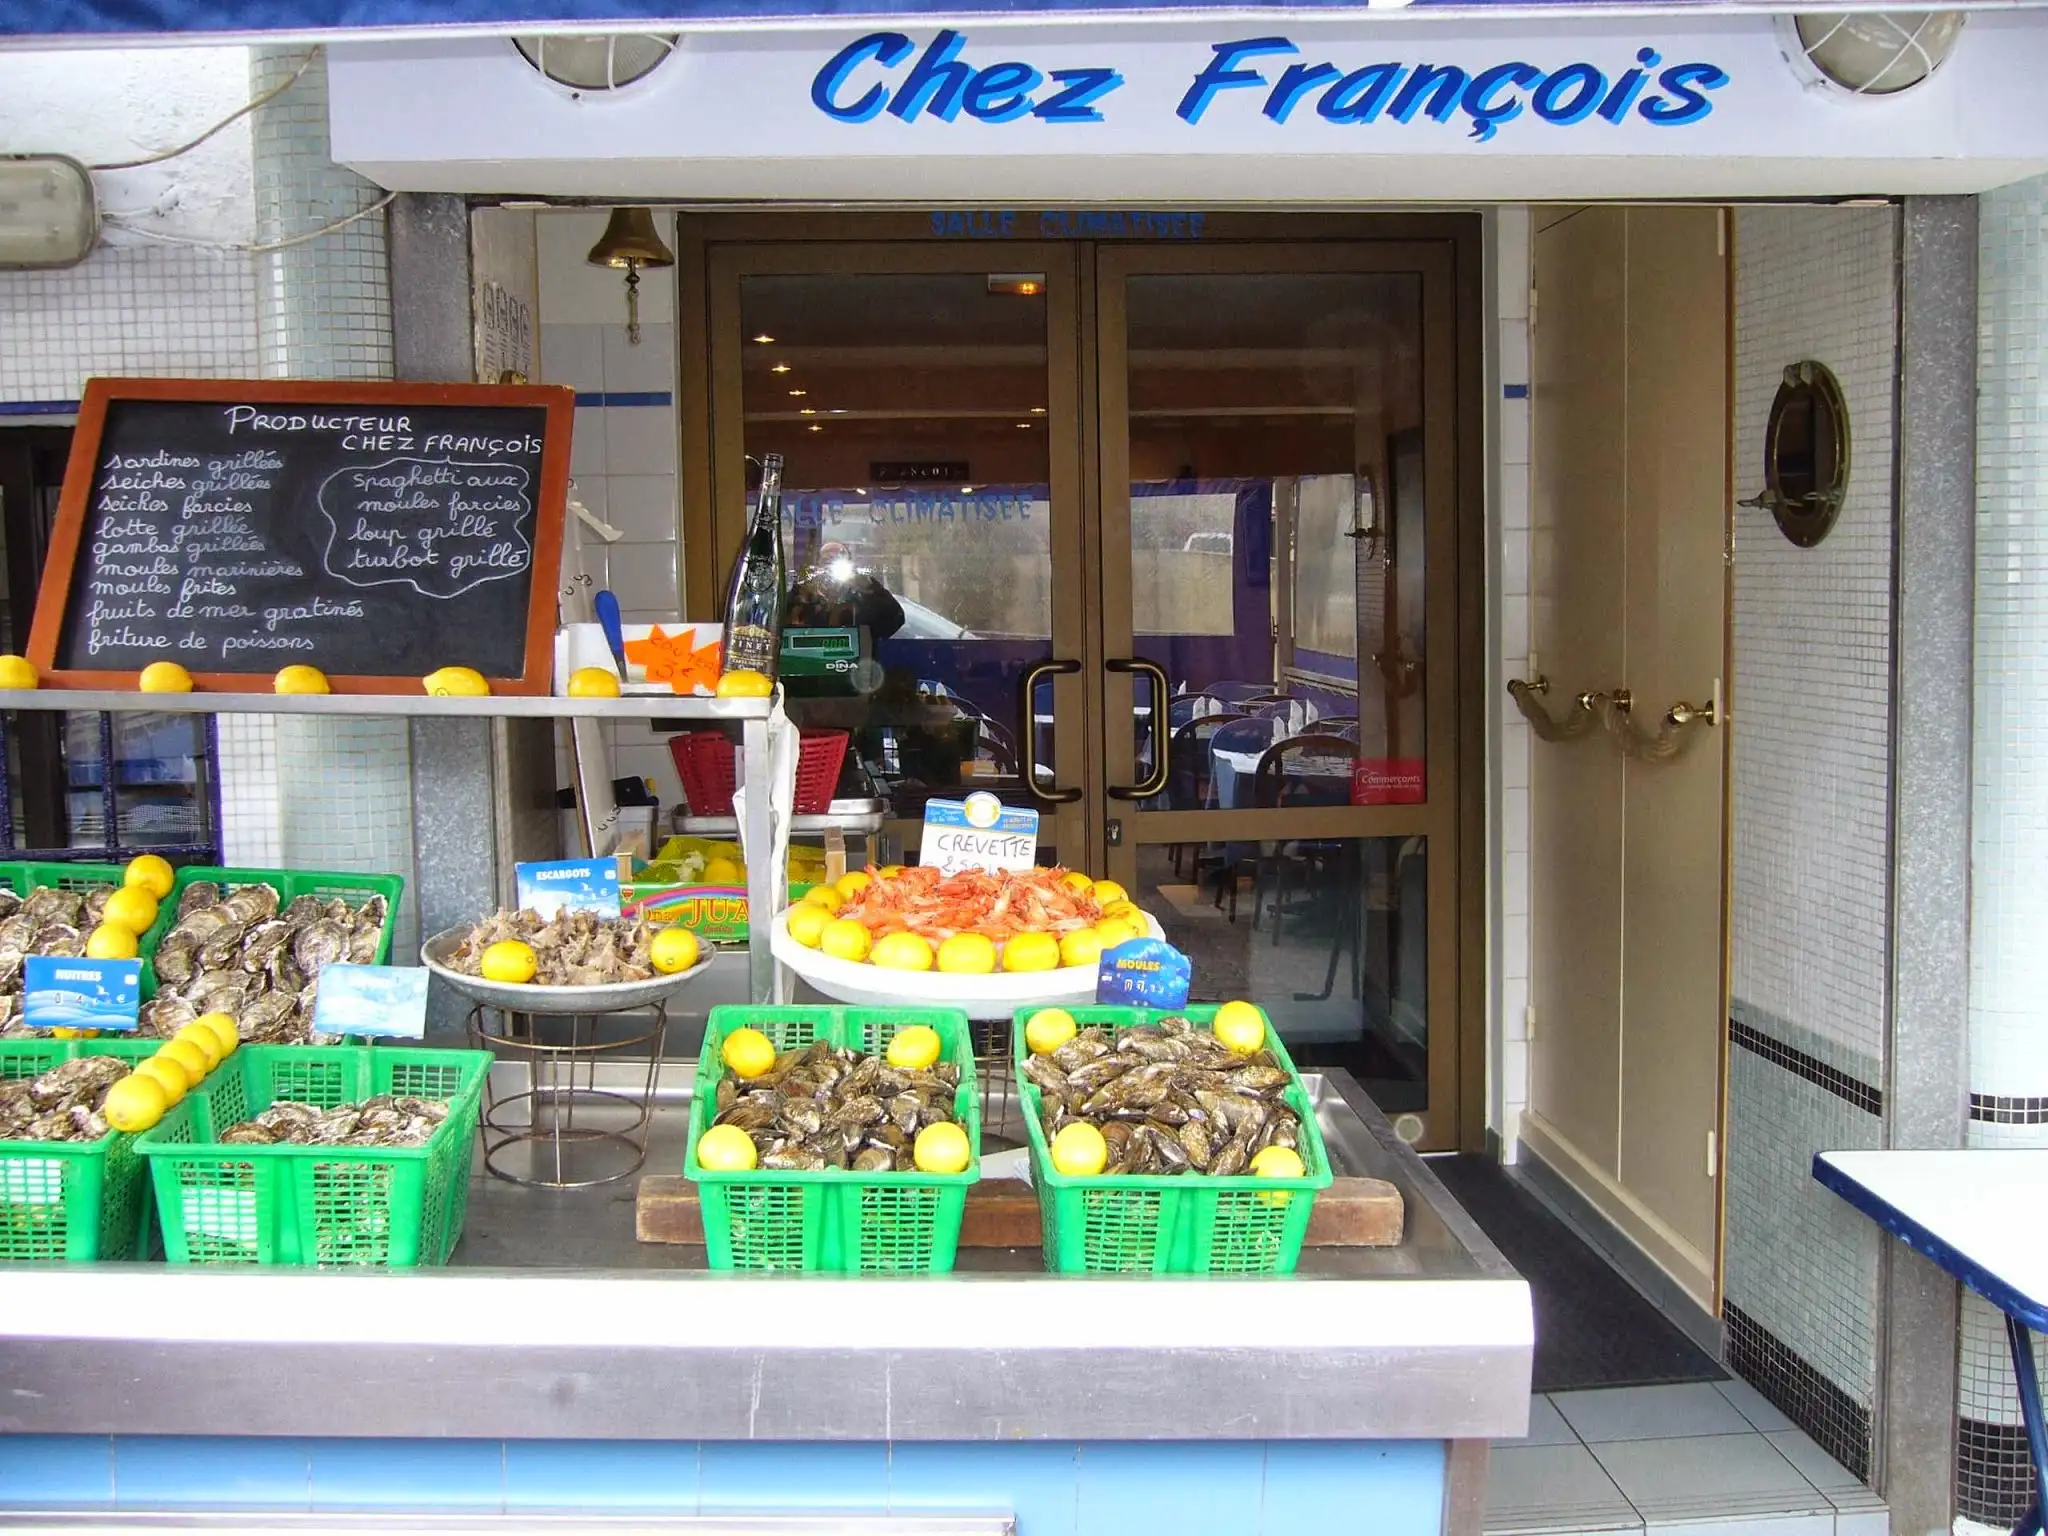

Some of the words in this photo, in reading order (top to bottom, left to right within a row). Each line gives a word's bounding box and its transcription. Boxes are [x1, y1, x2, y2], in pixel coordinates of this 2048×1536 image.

[810, 29, 1124, 126] Chez
[1176, 36, 1732, 143] François
[929, 211, 1016, 237] SALLE
[224, 405, 412, 435] PRODUCTEUR
[342, 435, 415, 451] CHEZ
[104, 449, 200, 469] sardines
[208, 450, 284, 479] grillées
[100, 471, 187, 490] seiches
[192, 473, 271, 499] grillées
[467, 475, 521, 487] aux
[98, 492, 169, 511] seiches
[183, 496, 253, 520] farcies
[357, 491, 440, 512] moules
[448, 491, 521, 521] farcies
[780, 496, 844, 527] ALLE
[95, 516, 159, 539] lotte
[172, 515, 253, 544] grillée
[348, 517, 407, 547] loup
[418, 515, 498, 548] grillé
[93, 537, 179, 564] gambas
[186, 535, 266, 563] grillées
[348, 545, 439, 570] turbot
[450, 542, 527, 578] grillé
[97, 557, 179, 577] moules
[185, 560, 304, 577] marinières
[90, 576, 171, 595] moules
[180, 576, 237, 603] frites
[86, 600, 156, 627] fruits
[167, 601, 193, 618] de
[199, 603, 257, 617] mer
[264, 597, 364, 631] gratinés
[88, 626, 172, 655] friture
[179, 631, 208, 649] de
[222, 630, 314, 658] poissons
[825, 661, 859, 671] DINA
[1361, 774, 1421, 785] Commerçants
[937, 834, 1031, 857] CREVETTE
[536, 868, 591, 881] ESCARGOTS
[685, 898, 749, 928] JUA
[1116, 959, 1161, 972] MOULES
